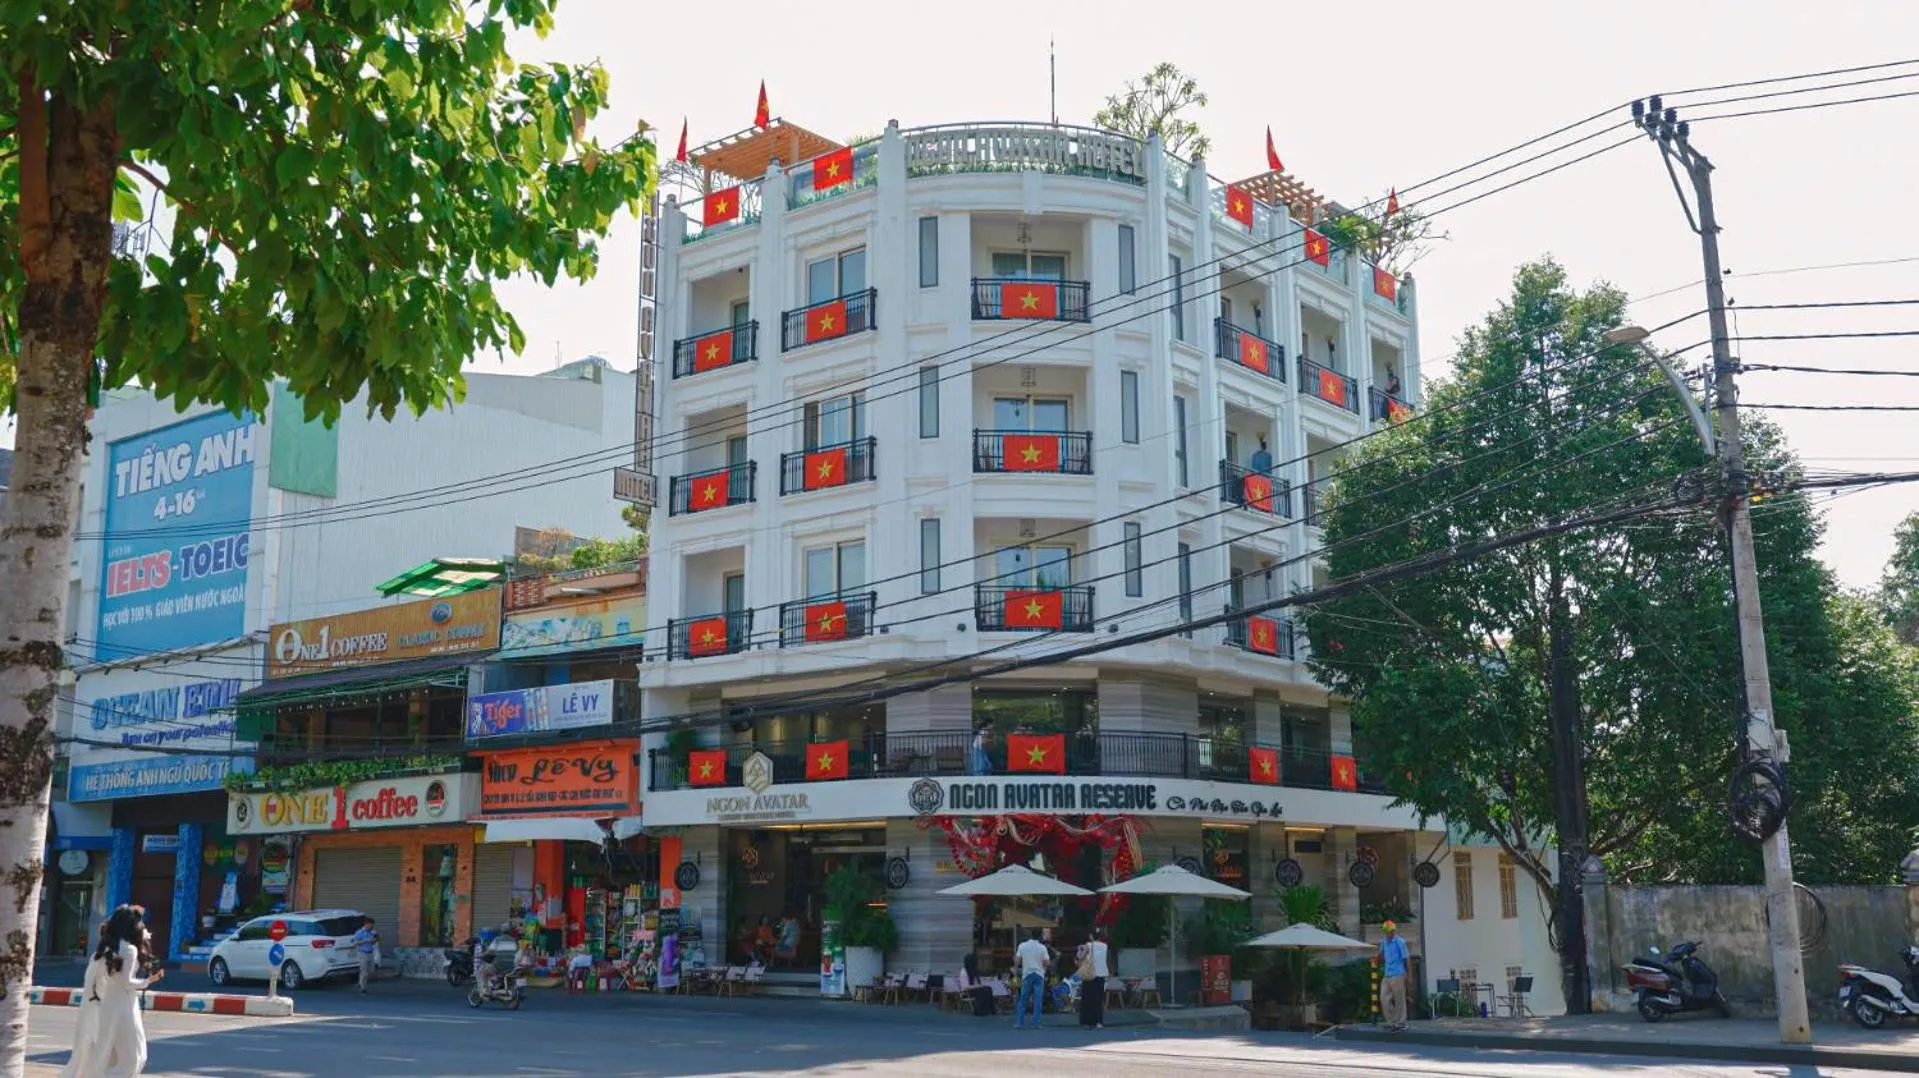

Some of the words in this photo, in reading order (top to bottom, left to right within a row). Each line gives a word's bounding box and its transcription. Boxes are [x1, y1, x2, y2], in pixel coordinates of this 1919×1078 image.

[115, 441, 193, 498] TIẾNG
[193, 423, 256, 477] ANH
[330, 632, 388, 658] COFFEE
[89, 685, 180, 731] OCEAN
[484, 698, 522, 729] Tiger
[562, 692, 578, 714] LÊ
[581, 694, 599, 712] VY
[136, 766, 159, 787] ANH
[571, 753, 620, 784] Vy
[259, 792, 329, 827] ONE
[352, 786, 419, 820] coffee
[706, 796, 750, 813] NGON
[753, 792, 809, 811] AVATAR
[949, 784, 998, 809] NGON
[1003, 784, 1076, 809] AVATAR
[1080, 784, 1157, 809] RESERVE
